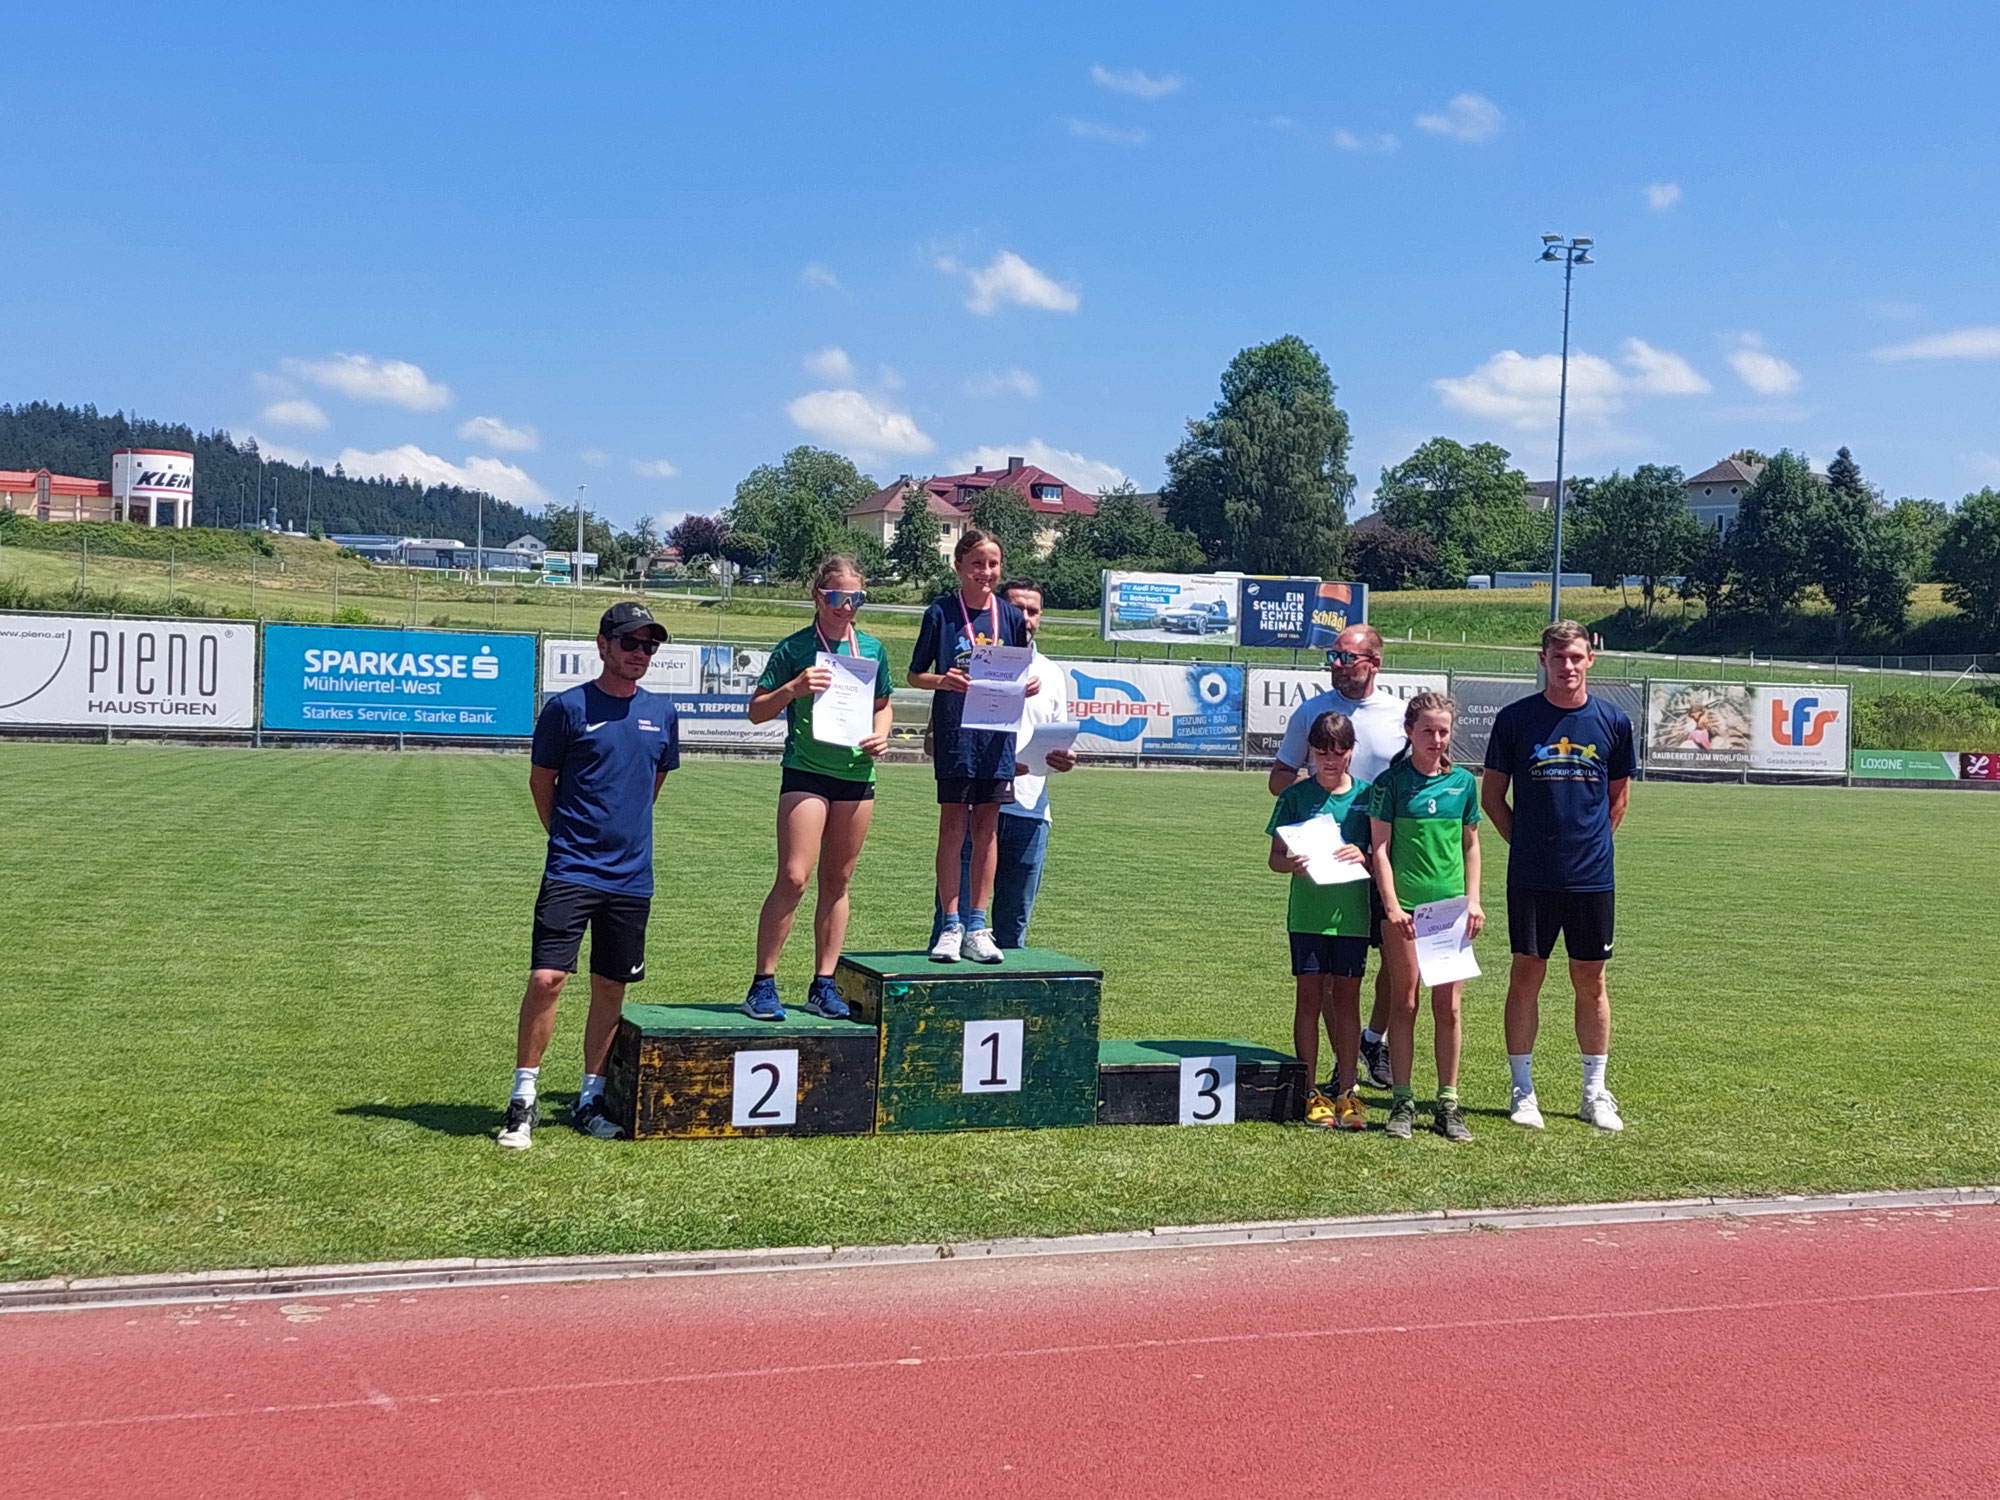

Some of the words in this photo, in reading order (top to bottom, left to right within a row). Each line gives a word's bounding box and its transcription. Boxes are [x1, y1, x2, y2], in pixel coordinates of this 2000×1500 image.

[1132, 584, 1149, 592] Audi
[1150, 585, 1178, 593] Partner
[1286, 592, 1305, 602] EIN
[1253, 600, 1305, 612] SCHLUCK
[1261, 611, 1304, 621] ECHTER
[1312, 609, 1347, 632] Schlägl
[1260, 621, 1303, 631] HEIMAT.
[0, 630, 66, 640] ww.pieno.at
[303, 649, 468, 679] SPARKASSE
[303, 675, 442, 696] Mühlviertel-West
[88, 699, 217, 716] HAUSTÜREN
[674, 702, 697, 714] DER,
[699, 703, 744, 713] TREPPEN
[1067, 700, 1170, 718] egenhart
[1467, 704, 1503, 714] GELDAN
[302, 706, 354, 720] Starkes
[357, 708, 411, 722] Service.
[414, 710, 456, 724] Starke
[460, 711, 497, 724] Bank.
[1176, 716, 1207, 725] HEIZUNG
[1213, 715, 1228, 723] BAD
[1458, 716, 1481, 725] ECHT.
[1482, 715, 1496, 726] FÜ
[1772, 697, 1839, 746] tfs
[1176, 725, 1238, 737] GEBÄUDETECHNIK
[1652, 751, 1694, 760] SAUBERKEIT
[1766, 757, 1828, 767] Gebäudereinigung
[1860, 757, 1903, 770] LOXONE
[1428, 798, 1436, 814] 3
[979, 1032, 1007, 1086] 1
[748, 1062, 781, 1119] 2
[1192, 1067, 1222, 1121] 3
